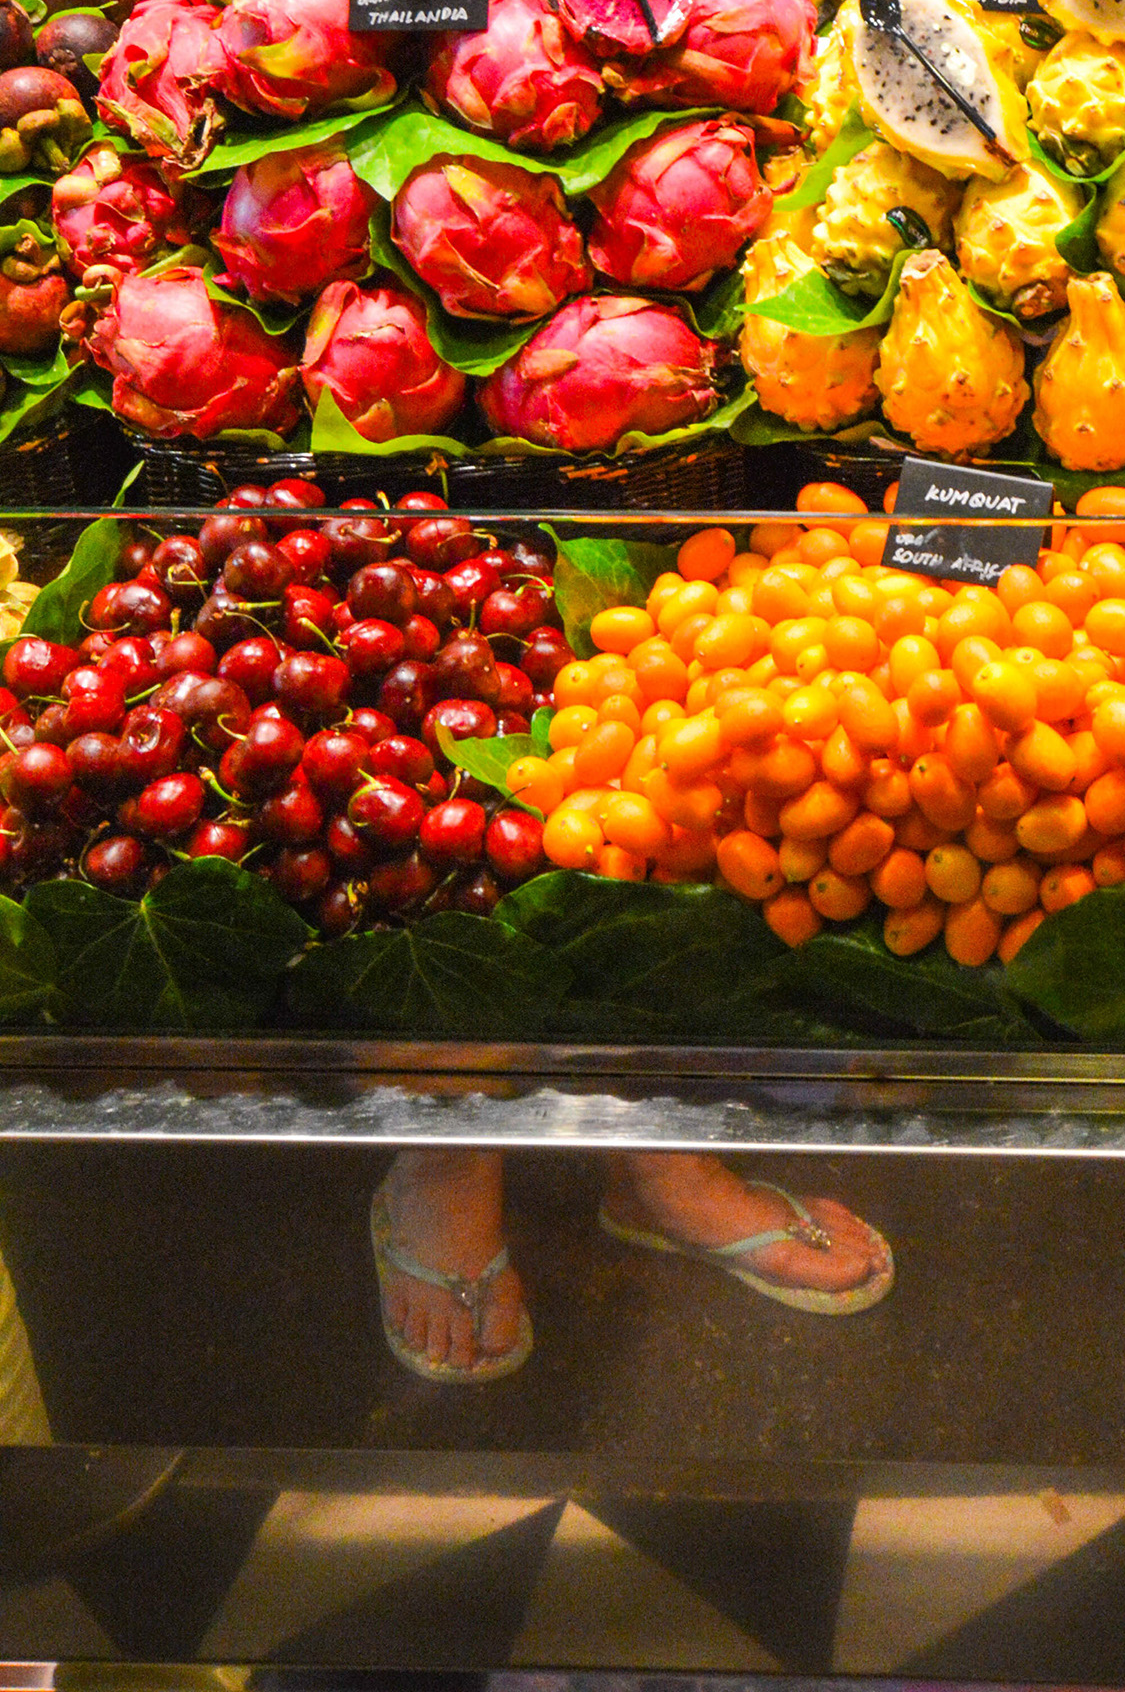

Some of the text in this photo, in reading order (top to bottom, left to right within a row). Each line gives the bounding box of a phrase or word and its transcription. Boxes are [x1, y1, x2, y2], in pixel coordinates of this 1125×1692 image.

[369, 6, 469, 26] THAILANDIA
[924, 484, 1027, 514] KUMQUAT
[892, 547, 944, 567] SOUTH
